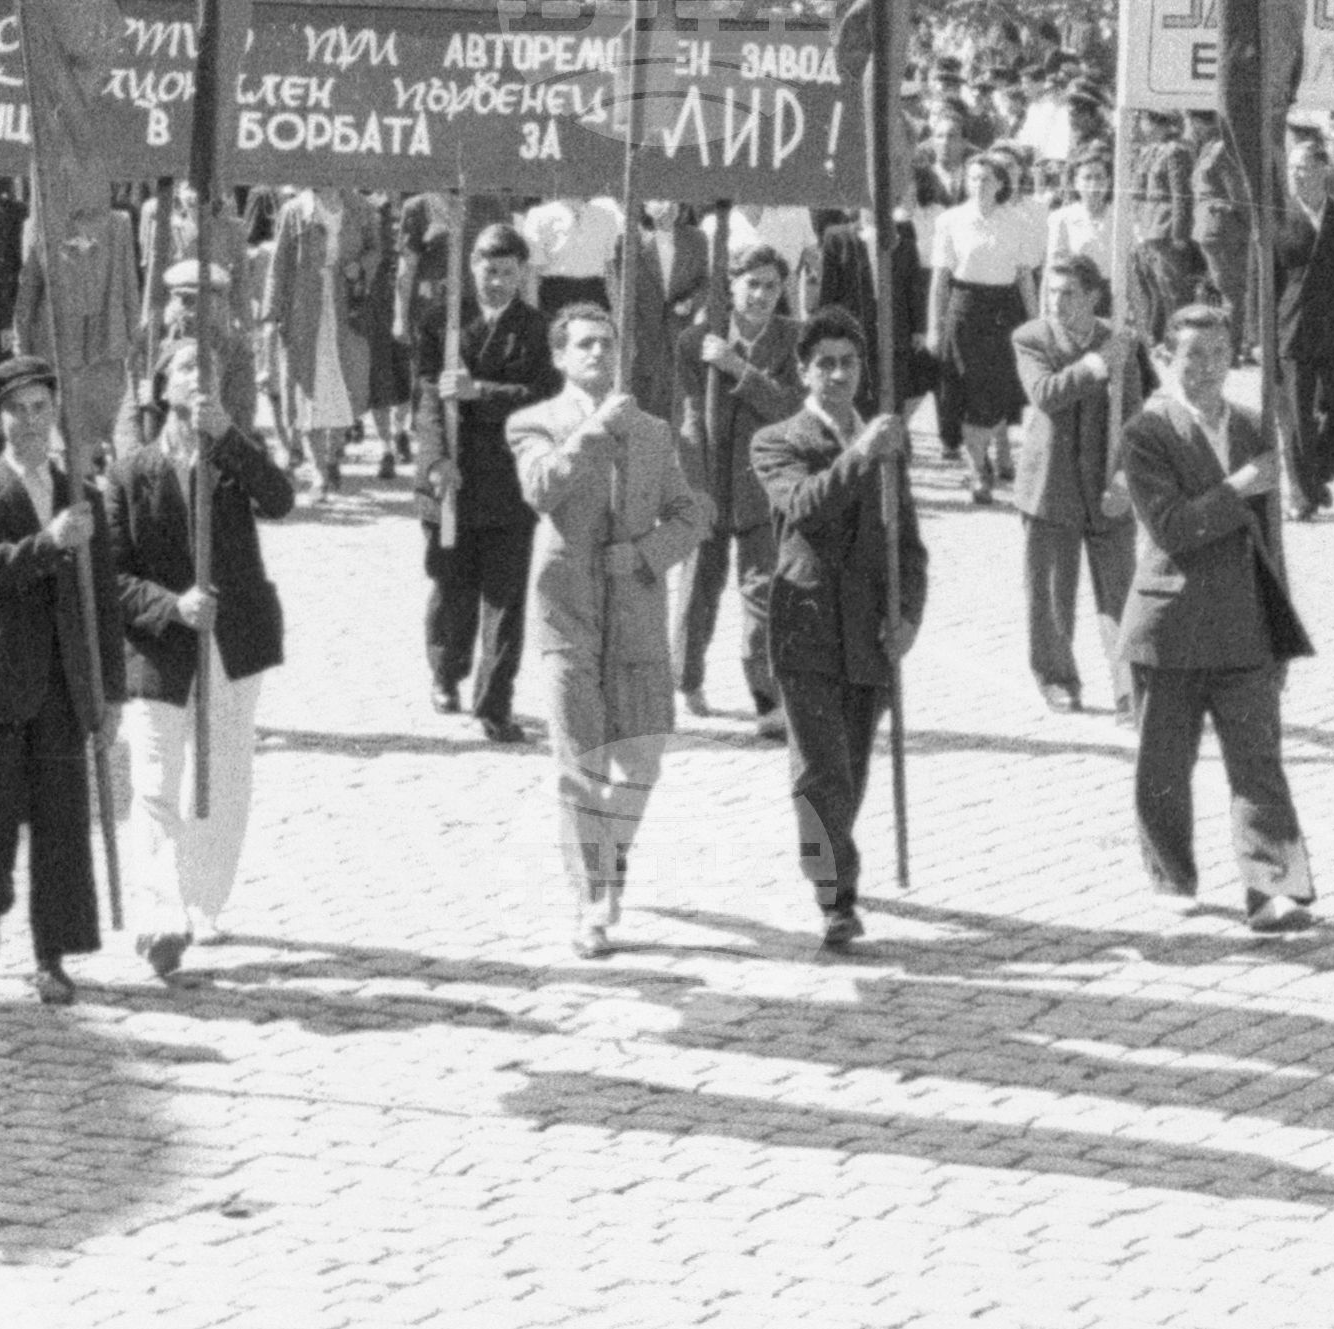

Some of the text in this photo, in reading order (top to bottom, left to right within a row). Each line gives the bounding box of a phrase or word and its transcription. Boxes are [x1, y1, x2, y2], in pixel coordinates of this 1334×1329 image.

[740, 40, 842, 85] ЗАВОД
[145, 107, 171, 148] В
[237, 108, 433, 156] БОРБАТА
[518, 118, 563, 161] ЗА
